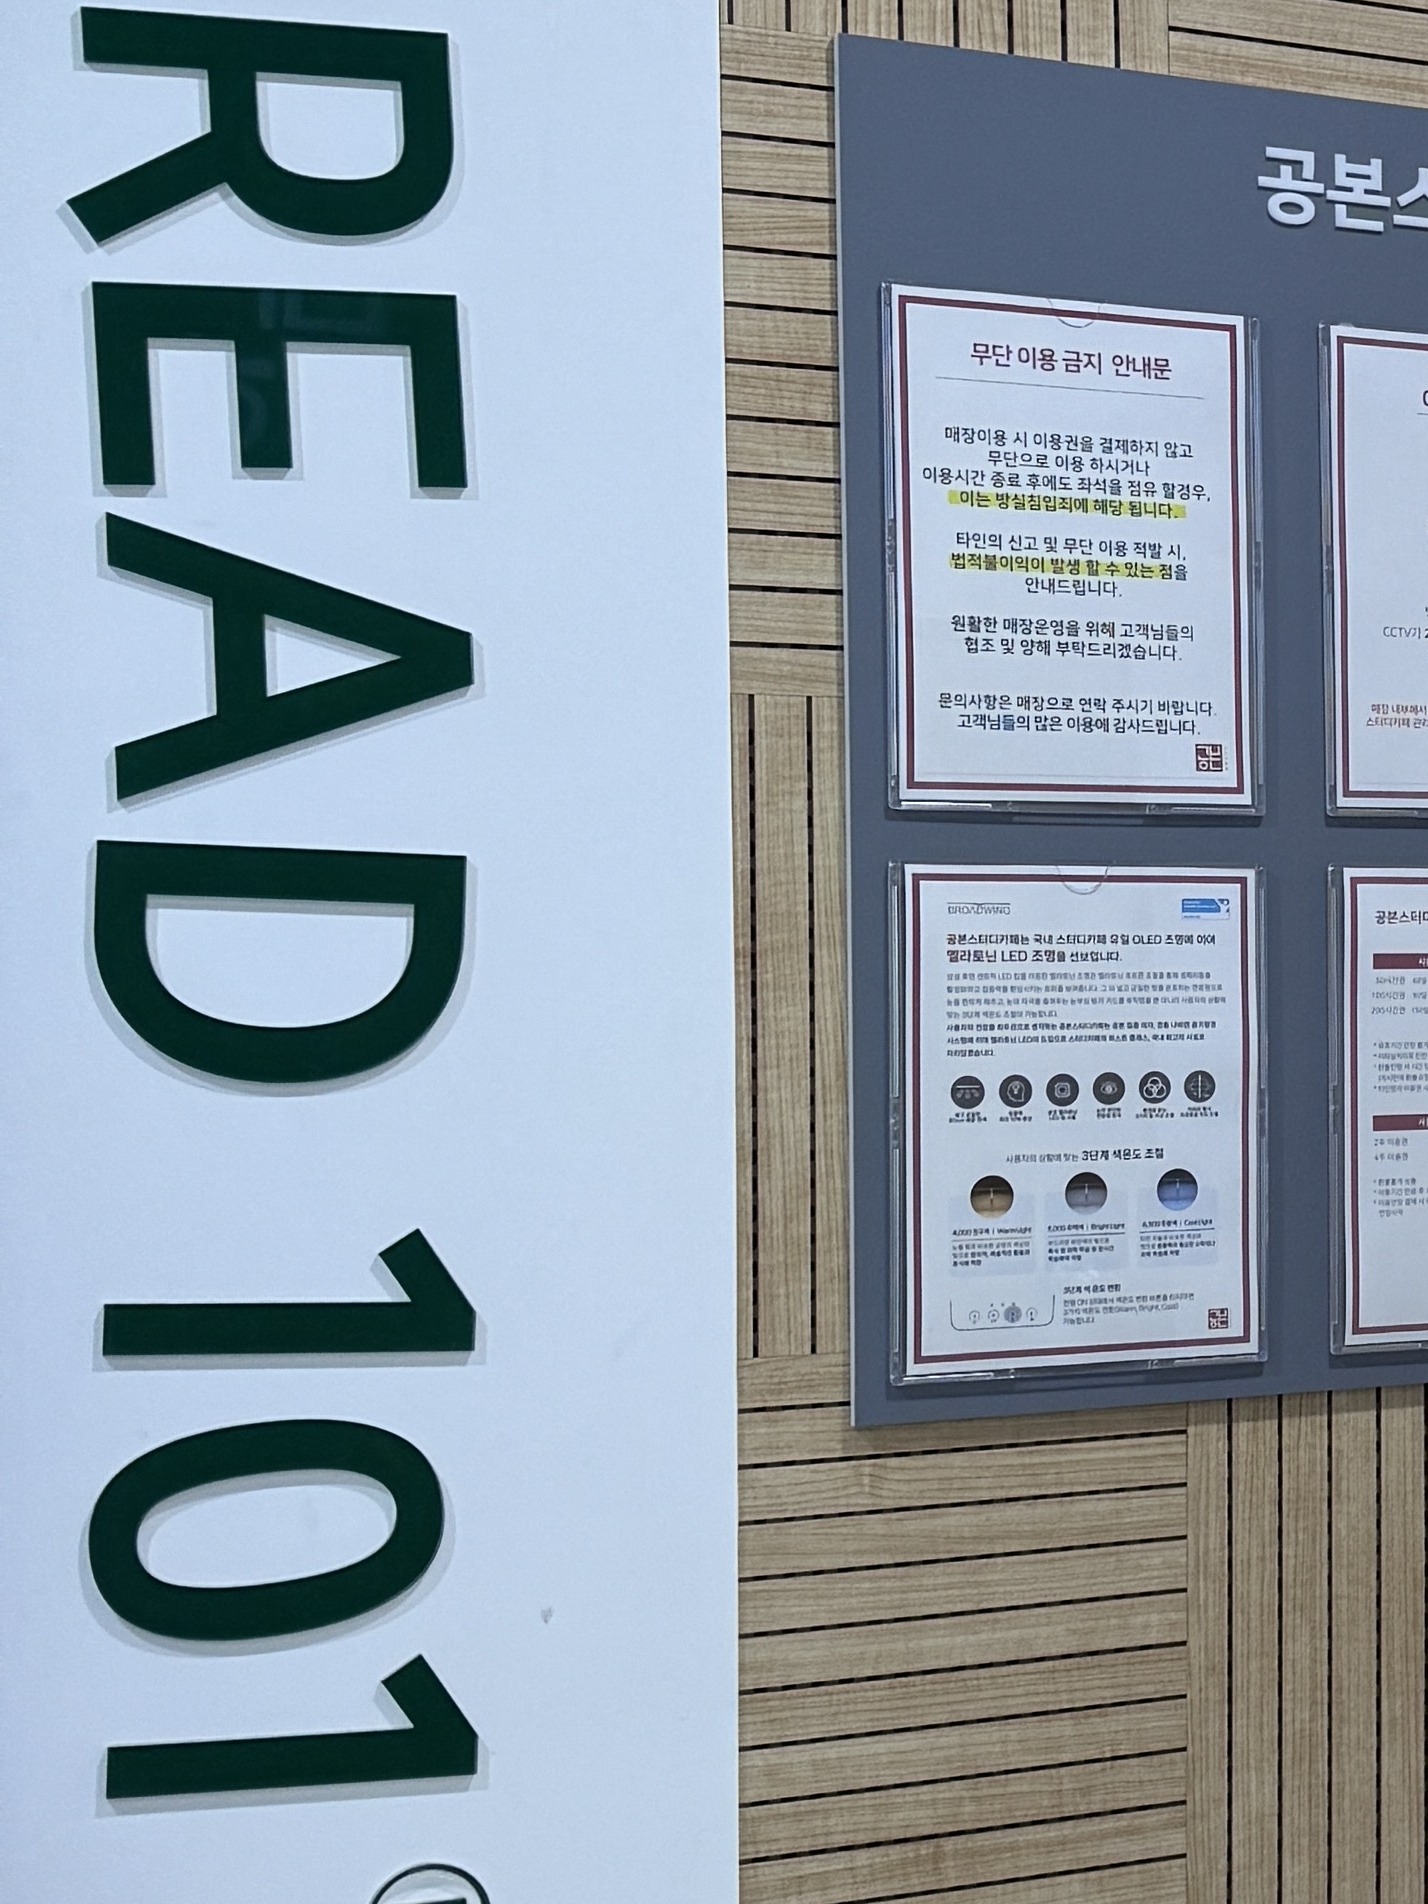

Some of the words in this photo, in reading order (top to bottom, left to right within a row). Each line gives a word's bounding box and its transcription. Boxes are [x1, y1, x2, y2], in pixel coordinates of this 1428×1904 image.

[971, 342, 1012, 368] 무단
[1018, 346, 1057, 372] 이용
[1062, 349, 1102, 375] 금지
[1112, 353, 1172, 380] 안내문
[945, 426, 1006, 448] 매장이용
[1013, 431, 1028, 449] 시
[1033, 432, 1094, 453] 이용권을
[1099, 436, 1159, 457] 결제하지
[1164, 440, 1193, 459] 않고
[988, 451, 1049, 470] 무단으로
[1055, 455, 1084, 472] 이용
[1090, 457, 1150, 476] 하시거나
[923, 466, 985, 488] 이용시간
[991, 471, 1022, 490] 종료
[1027, 473, 1073, 493] 후에도
[1078, 476, 1122, 496] 좌석을
[1127, 479, 1157, 498] 점유
[960, 490, 990, 508] 이는
[996, 492, 1089, 513] 방실침입죄에
[1094, 498, 1123, 516] 해당
[1128, 500, 1179, 519] 됩니다.
[65, 6, 474, 1085] READ
[956, 531, 1002, 551] 타인의
[1008, 534, 1038, 553] 신고
[1044, 536, 1058, 554] 및
[1063, 537, 1092, 556] 무단
[1099, 539, 1127, 557] 이용
[1134, 541, 1162, 559] 적발
[951, 553, 1045, 574] 법적불이익이
[1050, 558, 1080, 576] 발생
[1086, 560, 1100, 577] 할
[1105, 561, 1120, 578] 수
[1125, 562, 1154, 579] 있는
[1159, 563, 1187, 581] 점을
[1025, 578, 1122, 597] 안내드립니다.
[951, 614, 997, 634] 원활한
[1003, 617, 1080, 638] 매장운영을
[1086, 620, 1115, 639] 위해
[1120, 621, 1193, 642] 고객님들의
[965, 636, 996, 655] 협조
[1000, 637, 1014, 655] 및
[1020, 638, 1051, 656] 양해
[1056, 639, 1182, 661] 부탁드리겠습니다.
[939, 693, 1012, 711] 문의사항은
[1017, 695, 1075, 713] 매장으로
[1079, 697, 1106, 714] 연락
[1112, 698, 1153, 715] 주시기
[1158, 699, 1216, 716] 바랍니다.
[958, 714, 1029, 731] 고객님들의
[1034, 716, 1063, 732] 많은
[1067, 717, 1109, 733] 이용에
[1114, 718, 1200, 735] 감사드립니다.
[86, 1226, 481, 1802] 101
